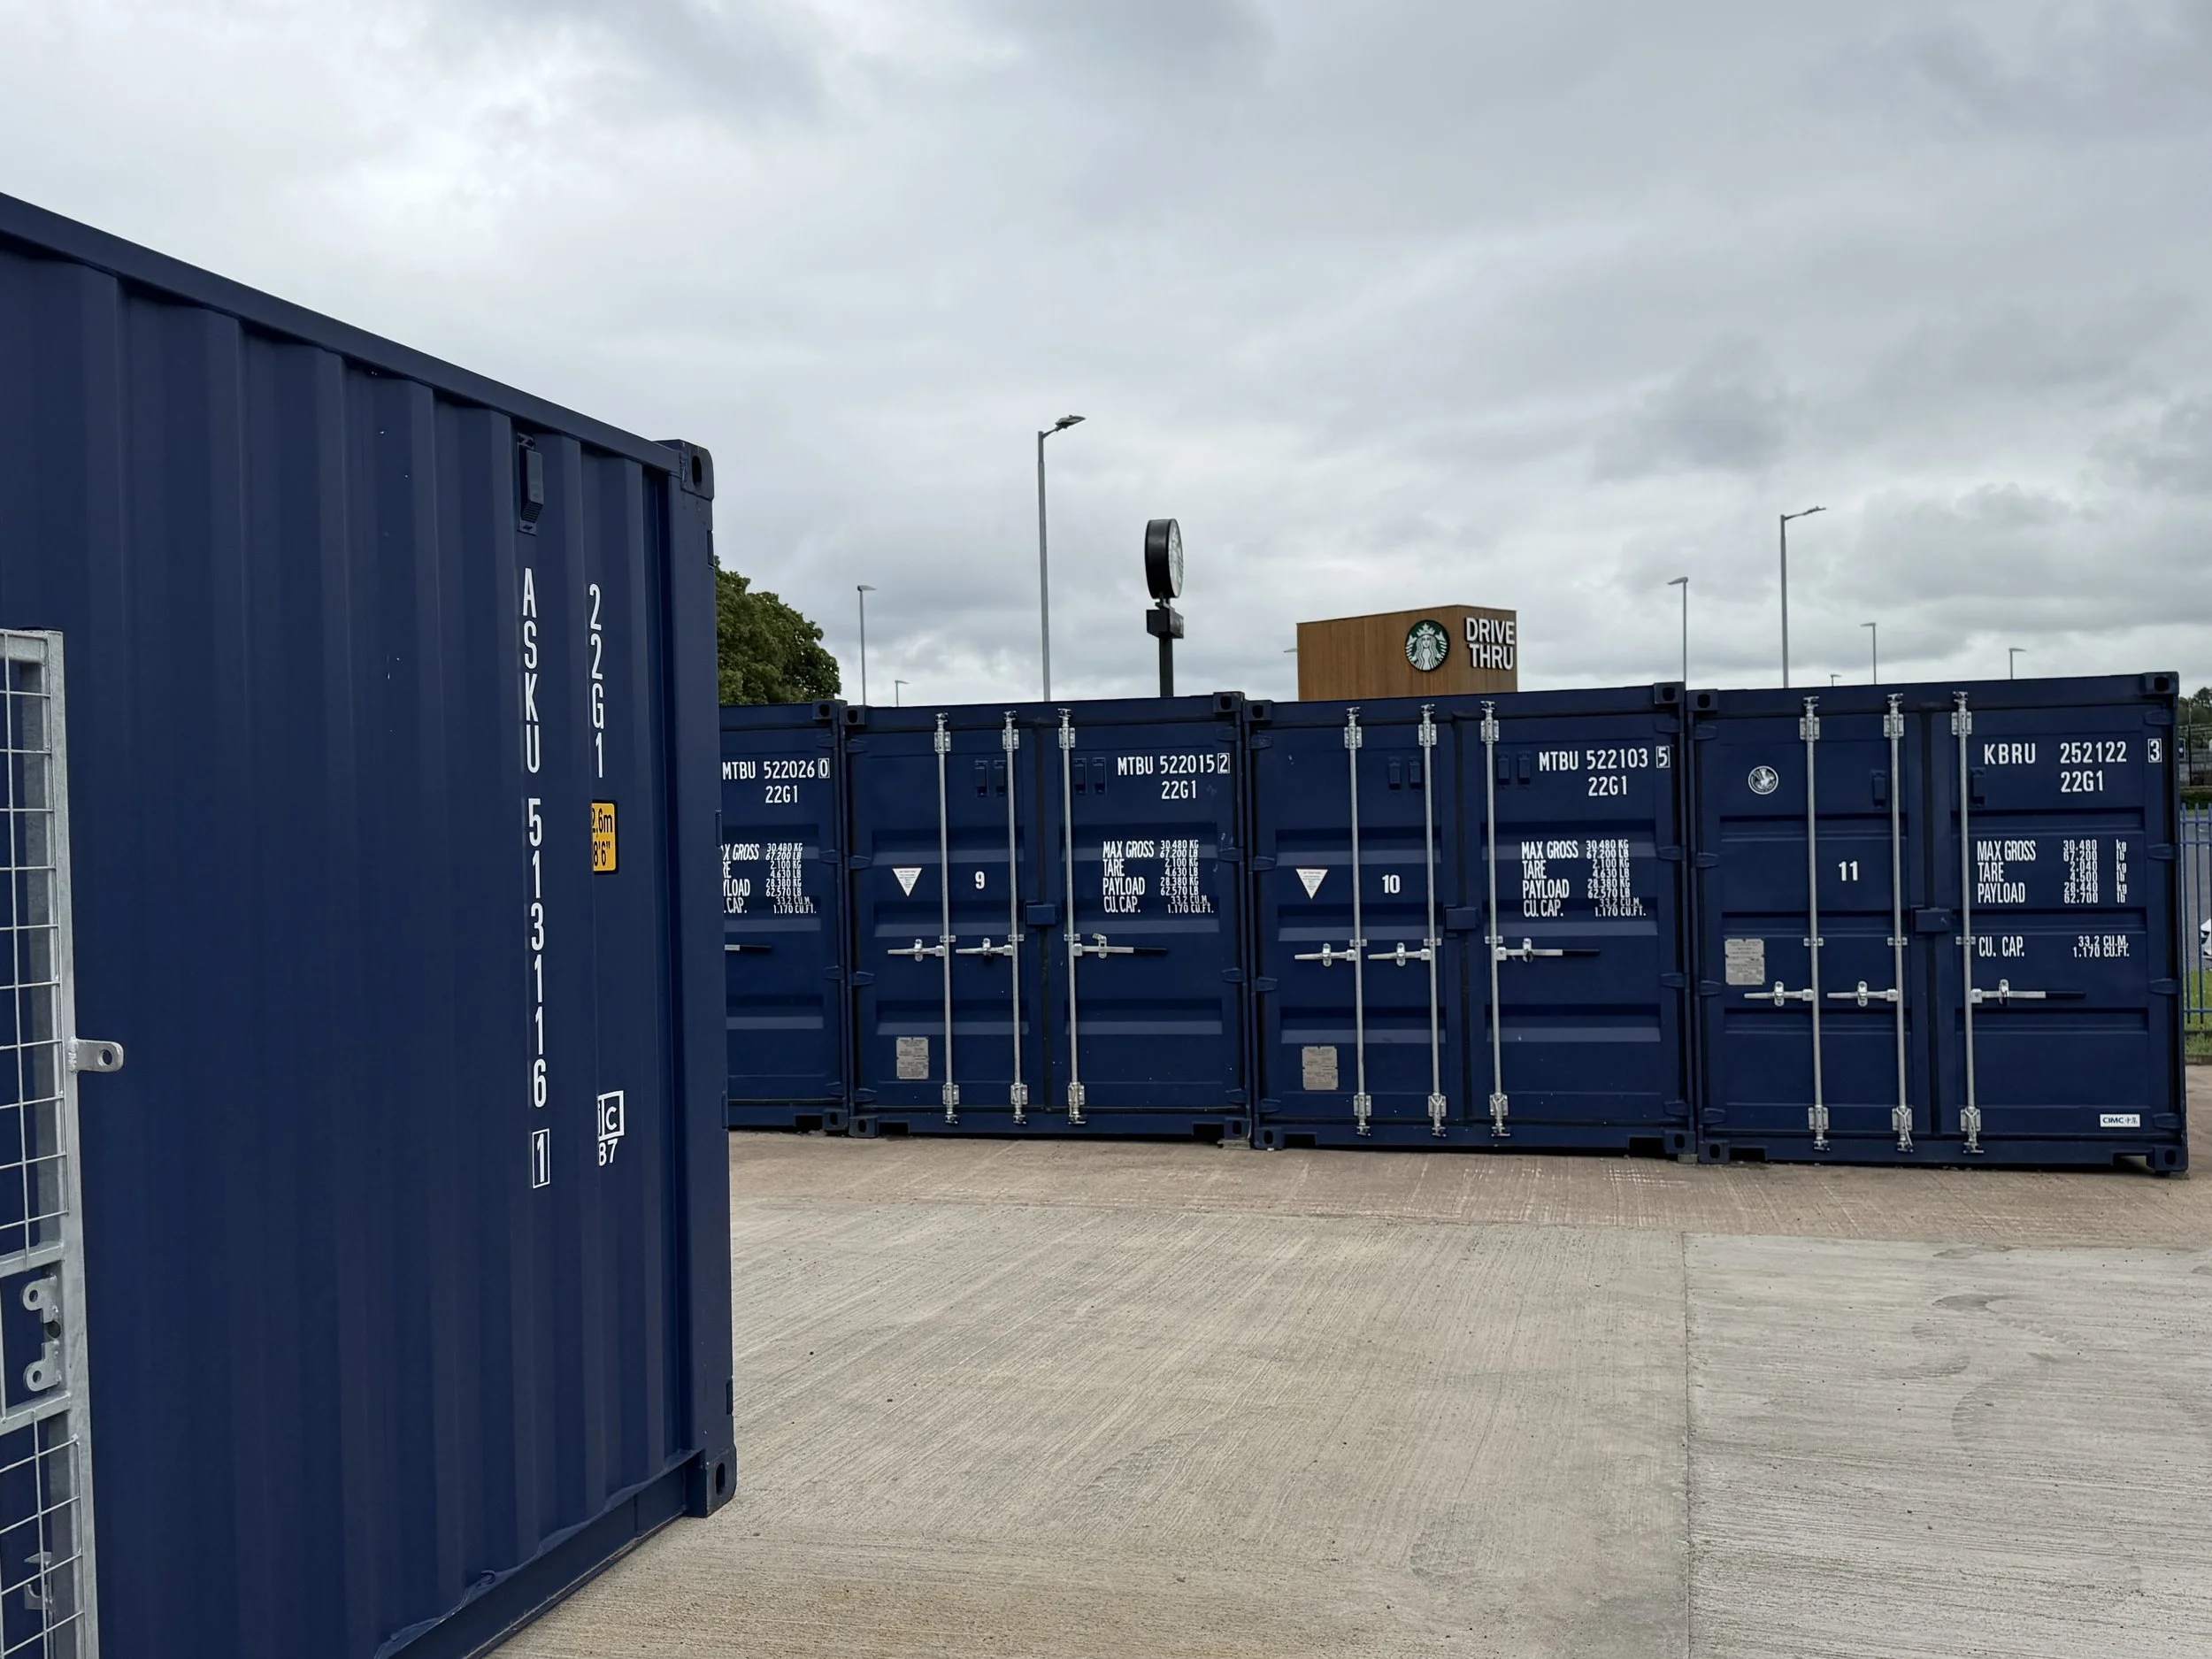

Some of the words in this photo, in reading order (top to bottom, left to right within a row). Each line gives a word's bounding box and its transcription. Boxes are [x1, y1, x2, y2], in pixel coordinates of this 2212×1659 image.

[1466, 617, 1515, 645] DRIVE
[1469, 643, 1514, 670] THRU
[523, 567, 541, 773] ASKU
[589, 584, 604, 778] 22G1
[1539, 750, 1578, 771] MTBU
[1586, 749, 1648, 770] 522103
[1657, 747, 1669, 767] 5
[1984, 742, 2036, 764] KBRU
[2060, 741, 2127, 764] 252122
[2149, 739, 2161, 762] 3
[722, 761, 756, 780] MTBU
[764, 760, 815, 779] 522026
[1117, 756, 1154, 776] MTBU
[1159, 754, 1215, 775] 522015
[1161, 780, 1196, 800] 22G1
[1588, 775, 1628, 796] 22G1
[2061, 770, 2103, 793] 22G1
[765, 785, 798, 803] 22G1
[733, 843, 760, 861] GROSS
[766, 842, 793, 852] 30.480
[794, 842, 803, 852] KG
[1102, 841, 1123, 858] MAX
[1125, 841, 1155, 858] GROSS
[1160, 840, 1187, 849] 30.480
[1189, 840, 1199, 849] KG
[1160, 849, 1187, 858] 67.200
[1189, 849, 1198, 858] LB
[1522, 841, 1544, 859] MAX
[1547, 841, 1578, 859] GROSS
[1586, 840, 1616, 850] 30.480
[1618, 839, 1629, 849] KG
[1977, 841, 2001, 861] MAX
[2004, 840, 2036, 861] GROSS
[2063, 840, 2097, 850] 30.480
[2116, 839, 2127, 852] kg
[765, 851, 791, 861] 67.200
[1164, 858, 1187, 867] 2.100
[1189, 857, 1199, 867] KG
[1586, 849, 1617, 859] 67.200
[1618, 849, 1629, 858] LB
[2063, 850, 2097, 862] 67.200
[2116, 849, 2125, 861] lb
[1102, 858, 1125, 877] TARE
[1164, 867, 1187, 877] 4.630
[1189, 867, 1198, 877] LB
[1522, 860, 1547, 879] TARE
[1593, 858, 1617, 869] 2.100
[1619, 858, 1630, 868] KG
[1839, 861, 1859, 881] 11
[1978, 862, 2004, 882] TARE
[2070, 861, 2097, 872] 2.040
[2116, 860, 2127, 873] kg
[974, 871, 985, 889] 9
[1160, 876, 1187, 887] 28.380
[1189, 876, 1199, 886] KG
[1593, 868, 1617, 879] 4.630
[1619, 868, 1630, 878] LB
[2070, 872, 2098, 882] 4.500
[2116, 871, 2125, 882] lb
[1102, 877, 1146, 895] PAYLOAD
[1160, 886, 1187, 895] 62.570
[1189, 886, 1199, 895] LB
[1382, 874, 1401, 894] 10
[1523, 879, 1570, 899] PAYLOAD
[1587, 878, 1617, 889] 28.380
[1620, 878, 1631, 888] KG
[1978, 882, 2025, 903] PAYLOAD
[2064, 881, 2098, 893] 28.440
[2116, 881, 2127, 895] kg
[1587, 888, 1618, 899] 62.570
[1620, 887, 1631, 898] LB
[2064, 892, 2098, 903] 62.700
[2116, 892, 2126, 903] lb
[1168, 904, 1188, 914] 1.170
[1594, 906, 1618, 917] 1.170
[528, 798, 547, 1108] 513116
[1978, 936, 1997, 957] CU.
[2001, 936, 2025, 957] CAP.
[2073, 946, 2101, 958] 1.170
[534, 1132, 547, 1185] 1
